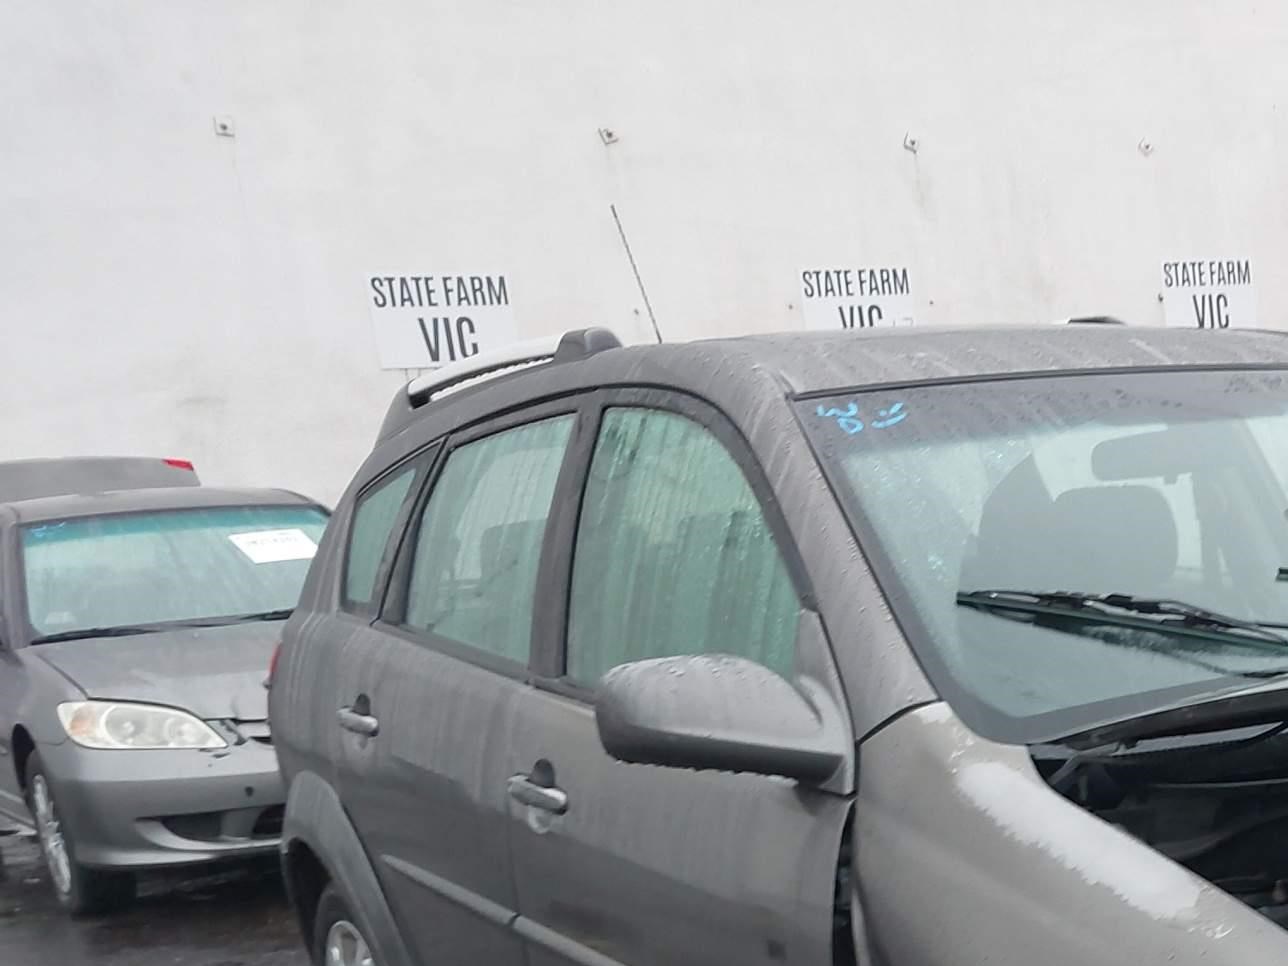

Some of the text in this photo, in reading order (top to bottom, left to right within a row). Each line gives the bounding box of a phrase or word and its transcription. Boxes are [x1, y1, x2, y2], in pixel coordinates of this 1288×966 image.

[802, 267, 910, 298] STATE FARM
[1163, 260, 1251, 288] STATE FARM
[371, 275, 509, 308] STATE FARM
[1192, 293, 1230, 329] VIC
[417, 316, 479, 362] VIC
